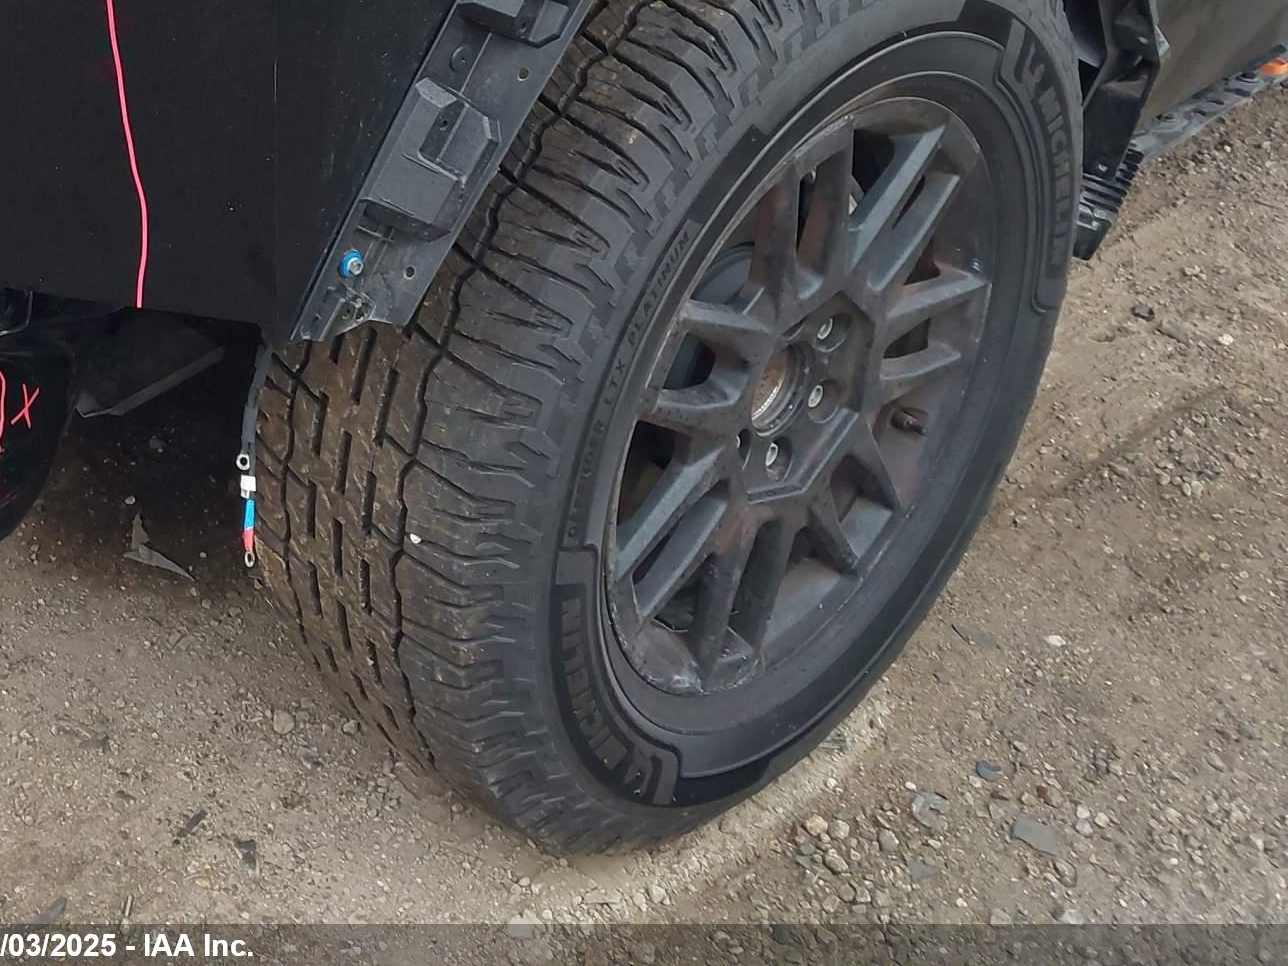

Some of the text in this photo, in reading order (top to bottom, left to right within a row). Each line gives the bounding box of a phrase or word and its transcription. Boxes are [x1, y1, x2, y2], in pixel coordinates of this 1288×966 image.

[1037, 84, 1072, 266] MICHELIN
[626, 231, 691, 347] PLATINUM
[561, 597, 629, 771] MICHELIN
